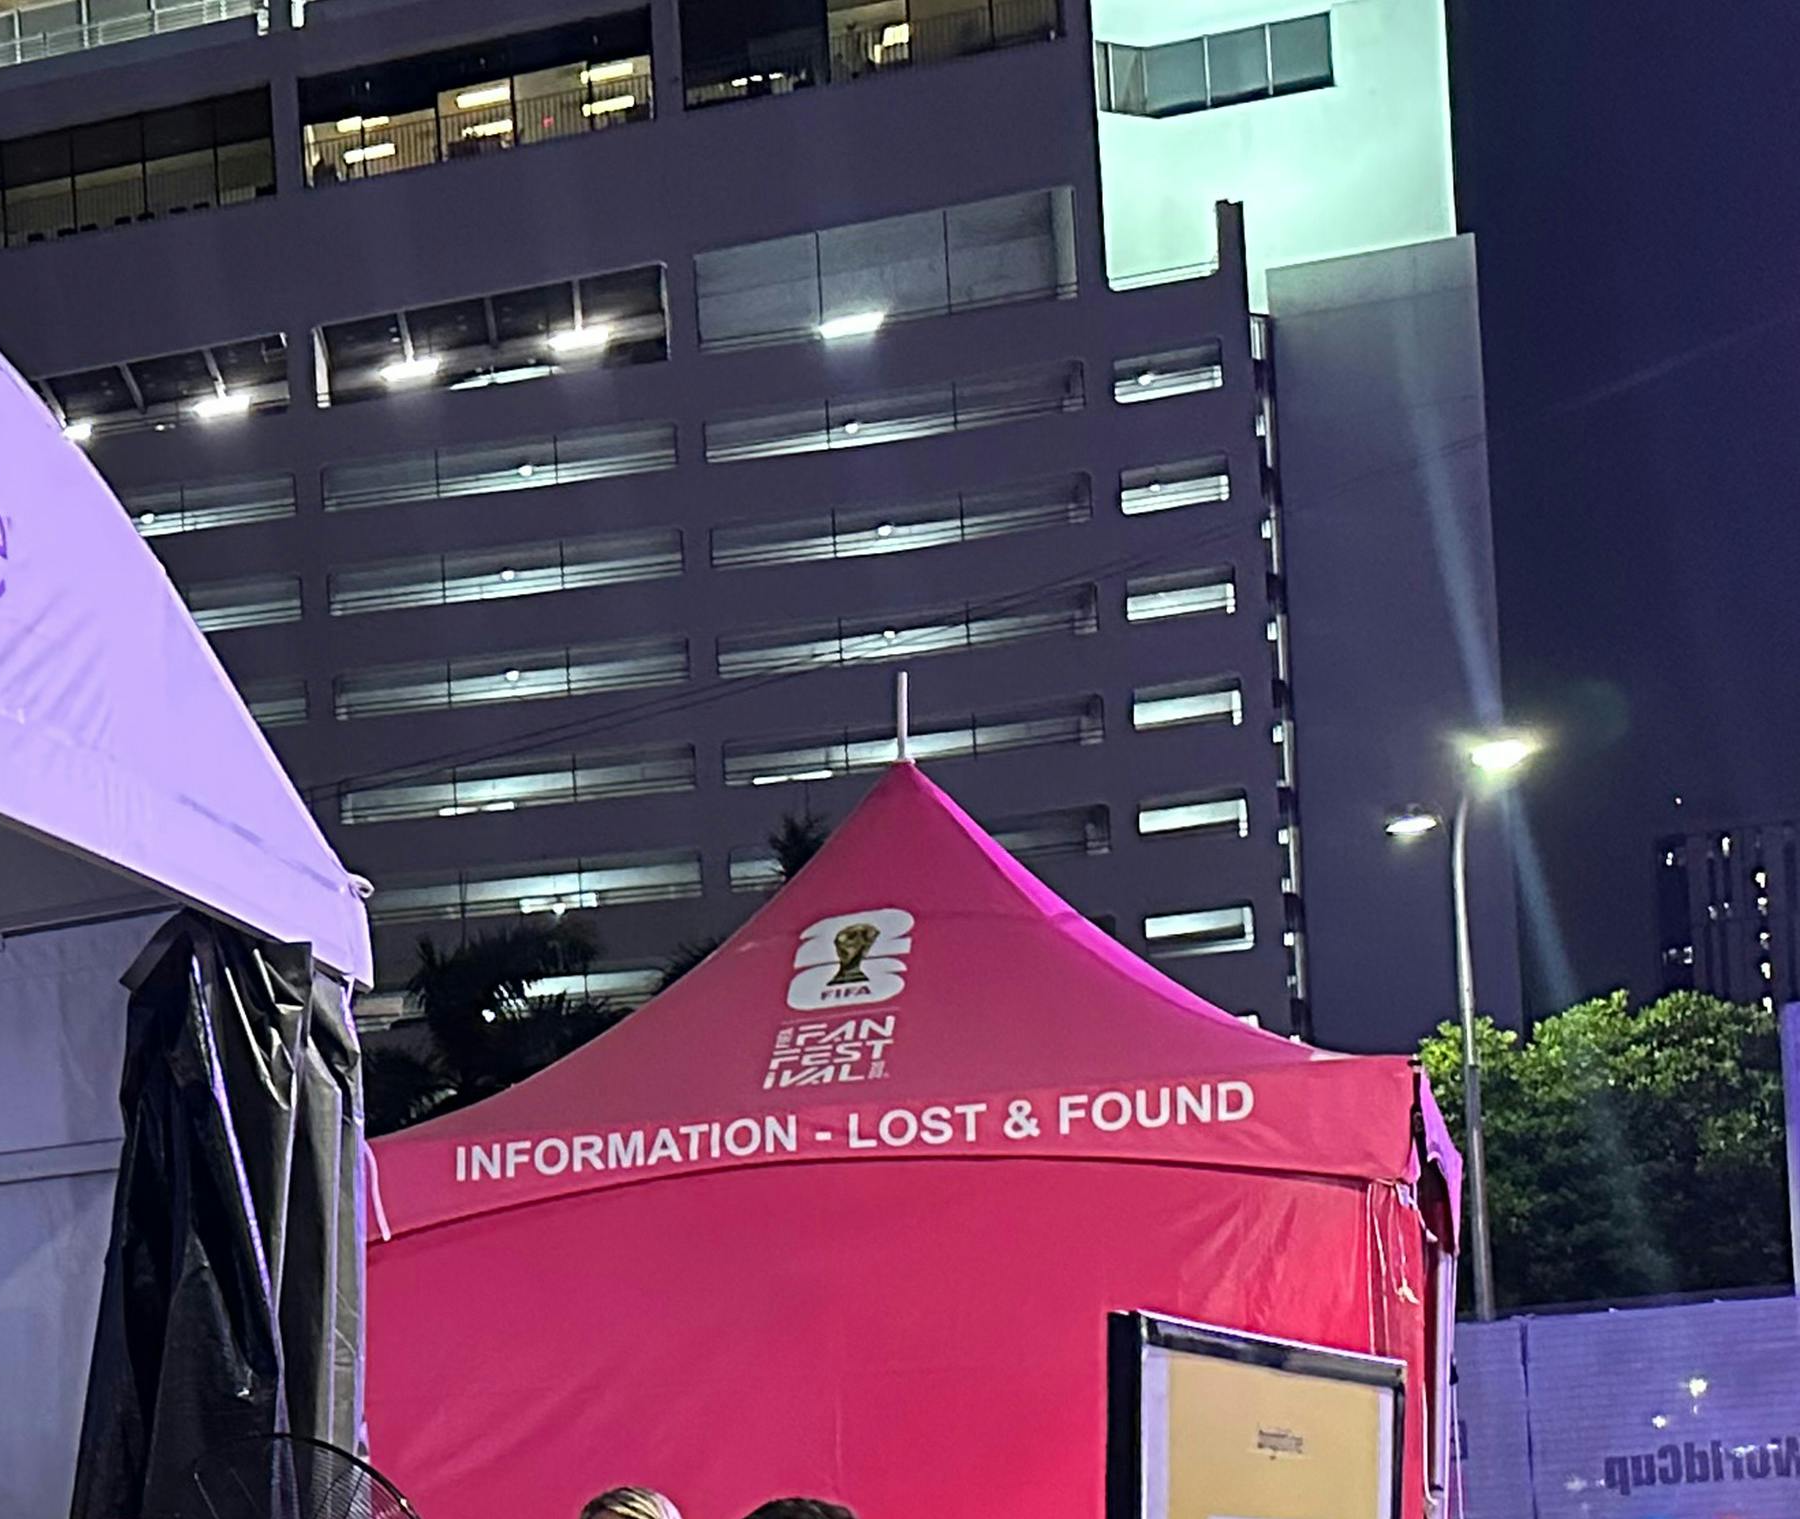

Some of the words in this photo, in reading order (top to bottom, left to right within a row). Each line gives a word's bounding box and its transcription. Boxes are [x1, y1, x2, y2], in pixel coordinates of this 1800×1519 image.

[820, 984, 873, 1001] FIFA
[795, 1014, 896, 1047] FAN
[768, 1038, 895, 1071] FEST
[455, 1114, 798, 1182] INFORMATION
[847, 1103, 988, 1149] LOST
[1002, 1098, 1041, 1140] &
[1058, 1080, 1255, 1136] FOUND
